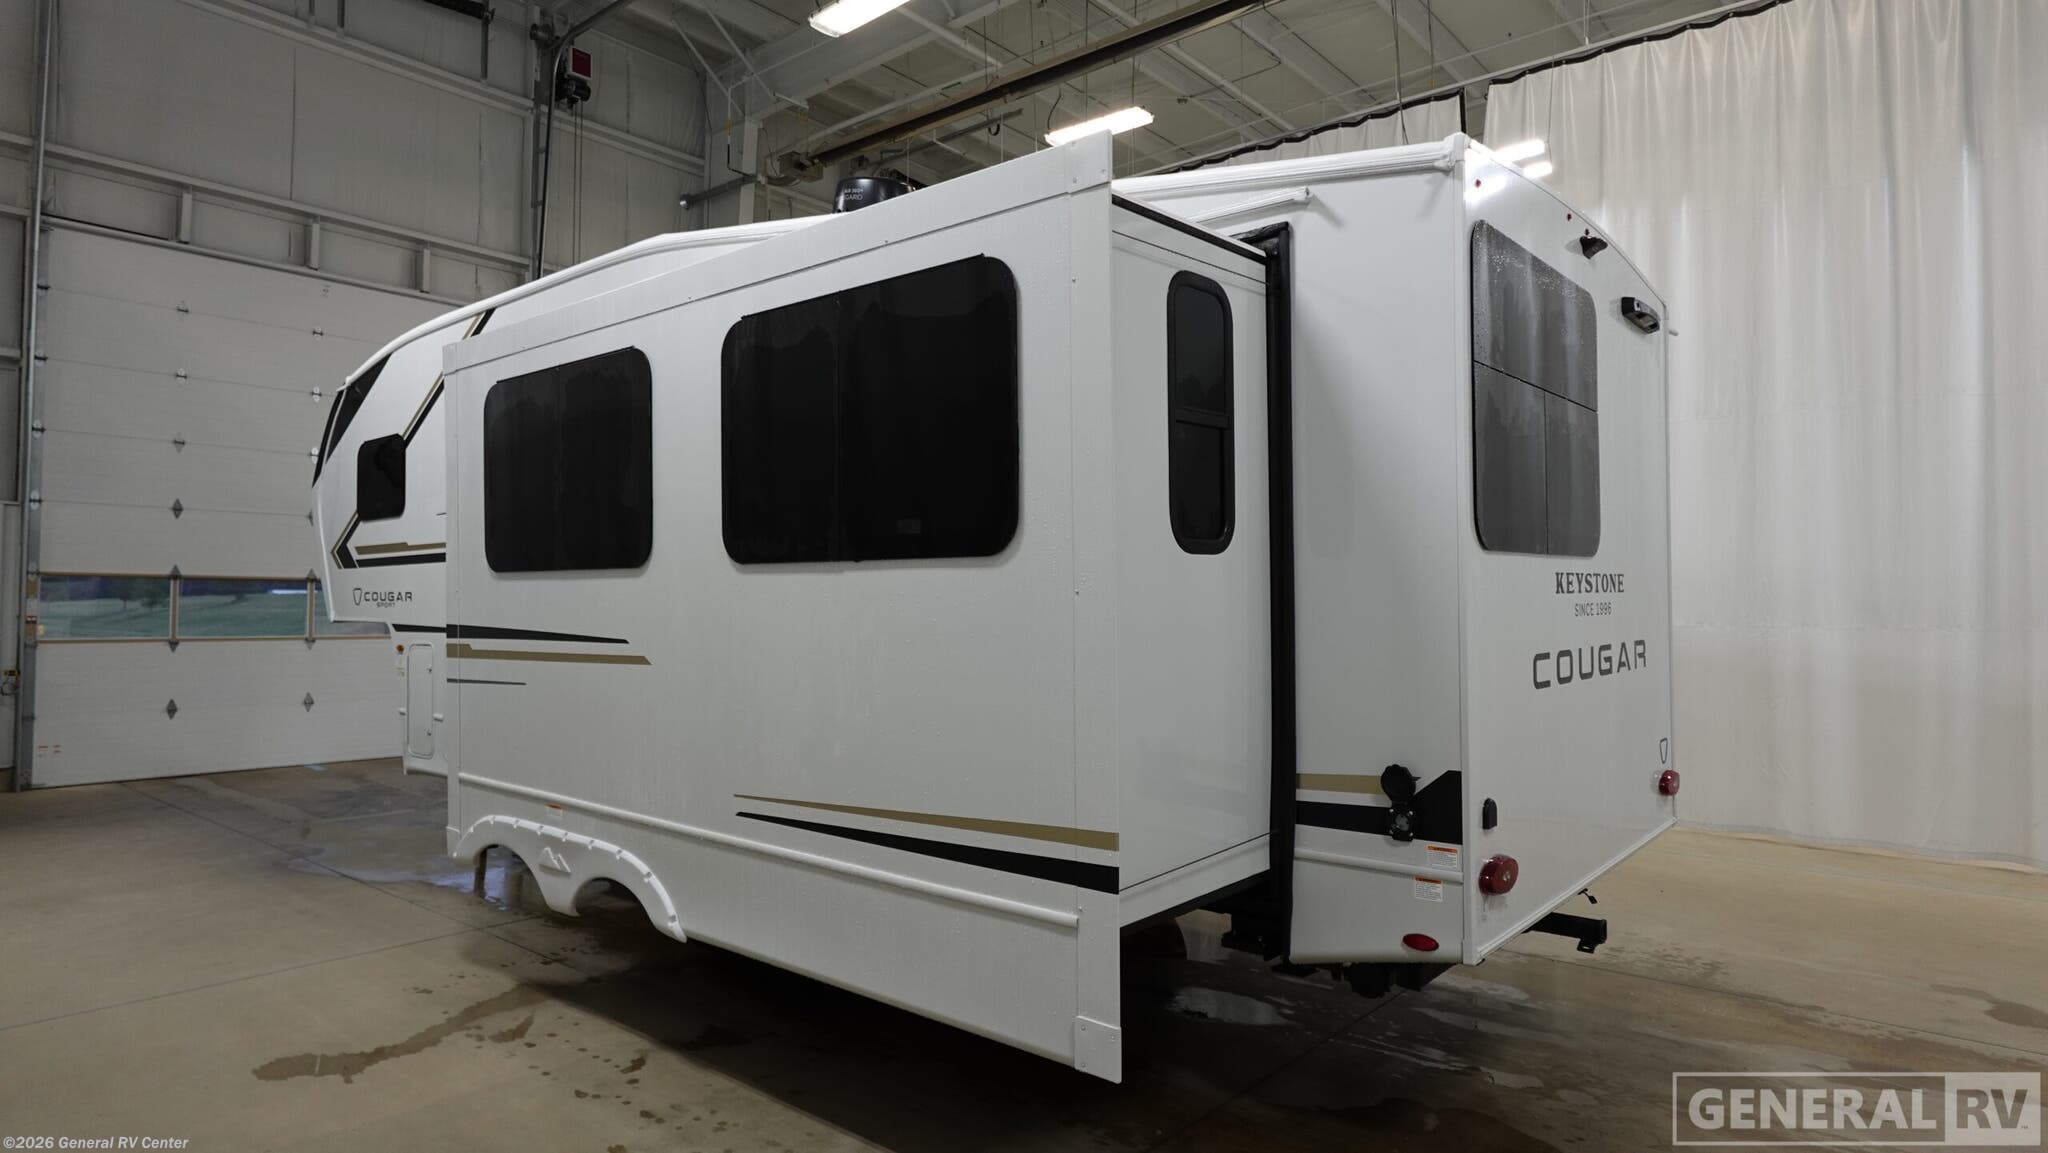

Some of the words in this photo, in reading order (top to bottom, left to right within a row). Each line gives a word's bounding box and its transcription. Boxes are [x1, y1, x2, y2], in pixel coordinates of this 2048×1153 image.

[1555, 572, 1625, 594] KEYSTONE
[364, 591, 413, 602] COUGAR
[1575, 603, 1594, 617] SINCE
[1596, 602, 1612, 616] 1996
[1533, 640, 1646, 690] COUGAR
